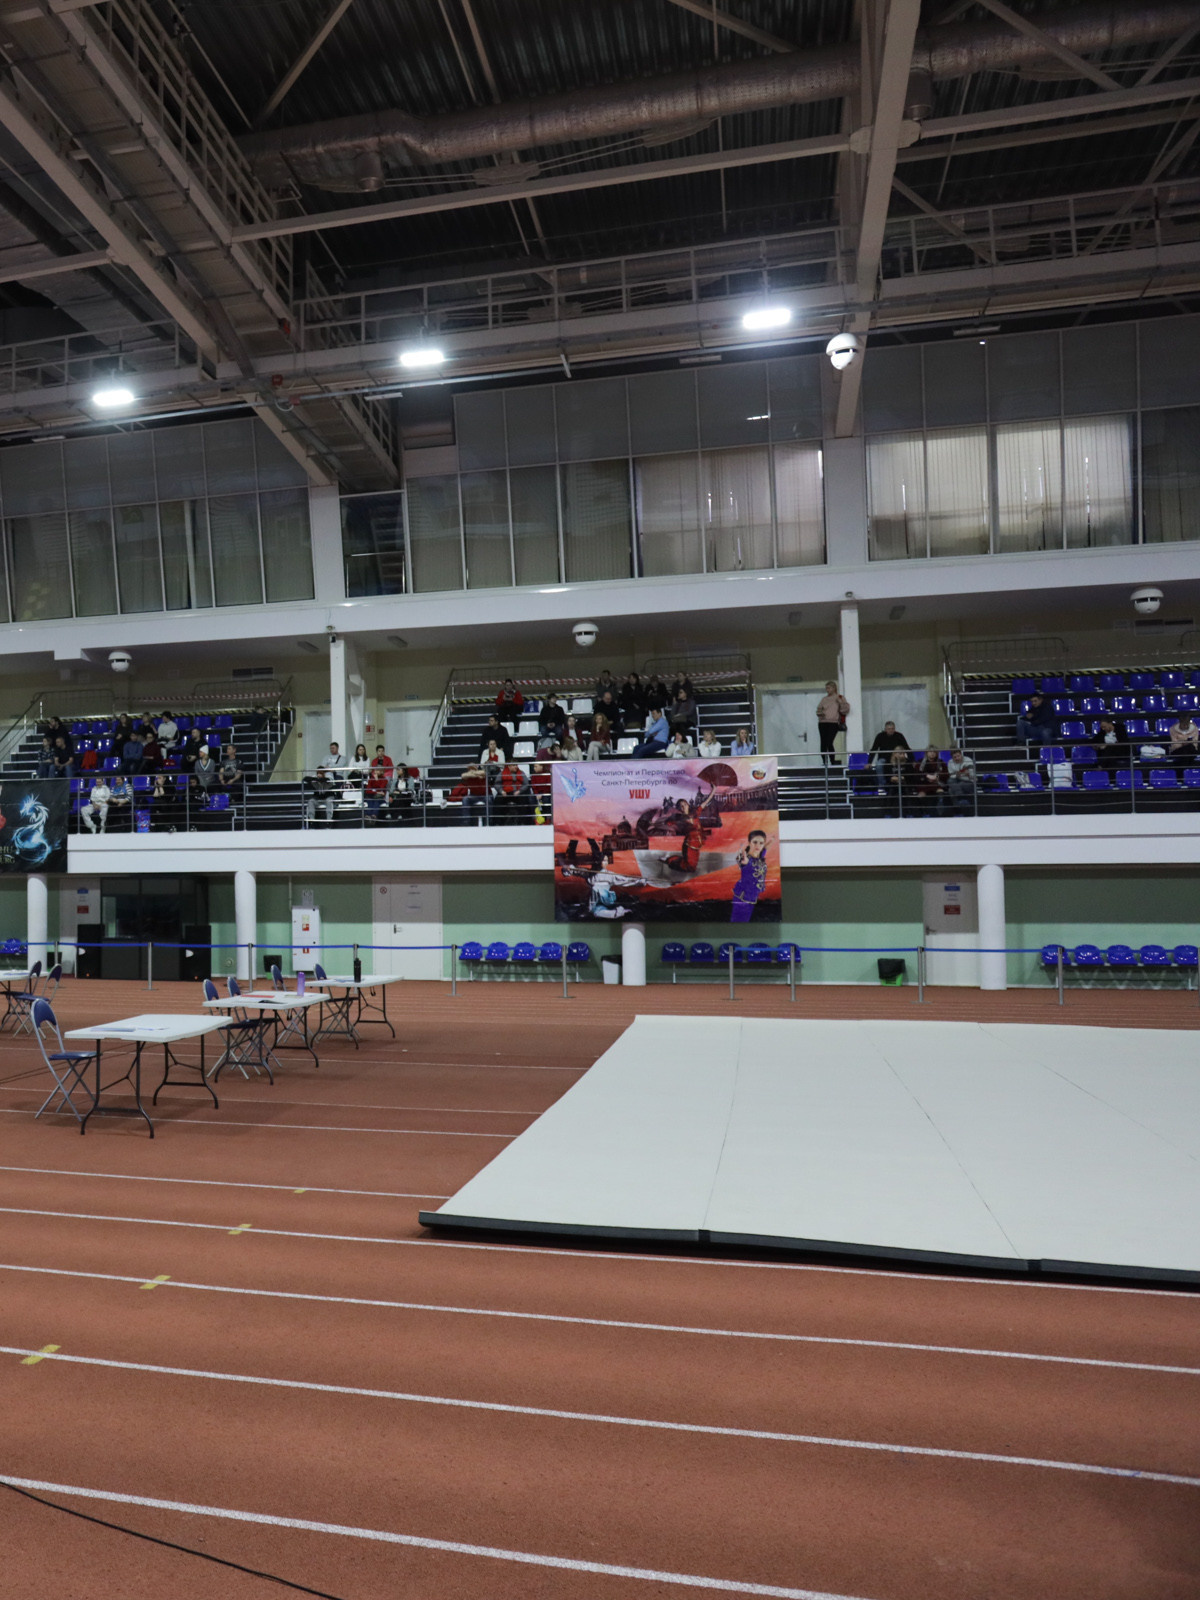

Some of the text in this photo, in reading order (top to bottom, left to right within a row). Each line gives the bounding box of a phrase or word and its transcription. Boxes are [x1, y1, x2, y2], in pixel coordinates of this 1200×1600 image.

[593, 769, 634, 777] Чемпионат
[641, 768, 685, 776] Первенство
[601, 778, 667, 787] Санкт-Петербурга
[629, 788, 651, 799] УШУ
